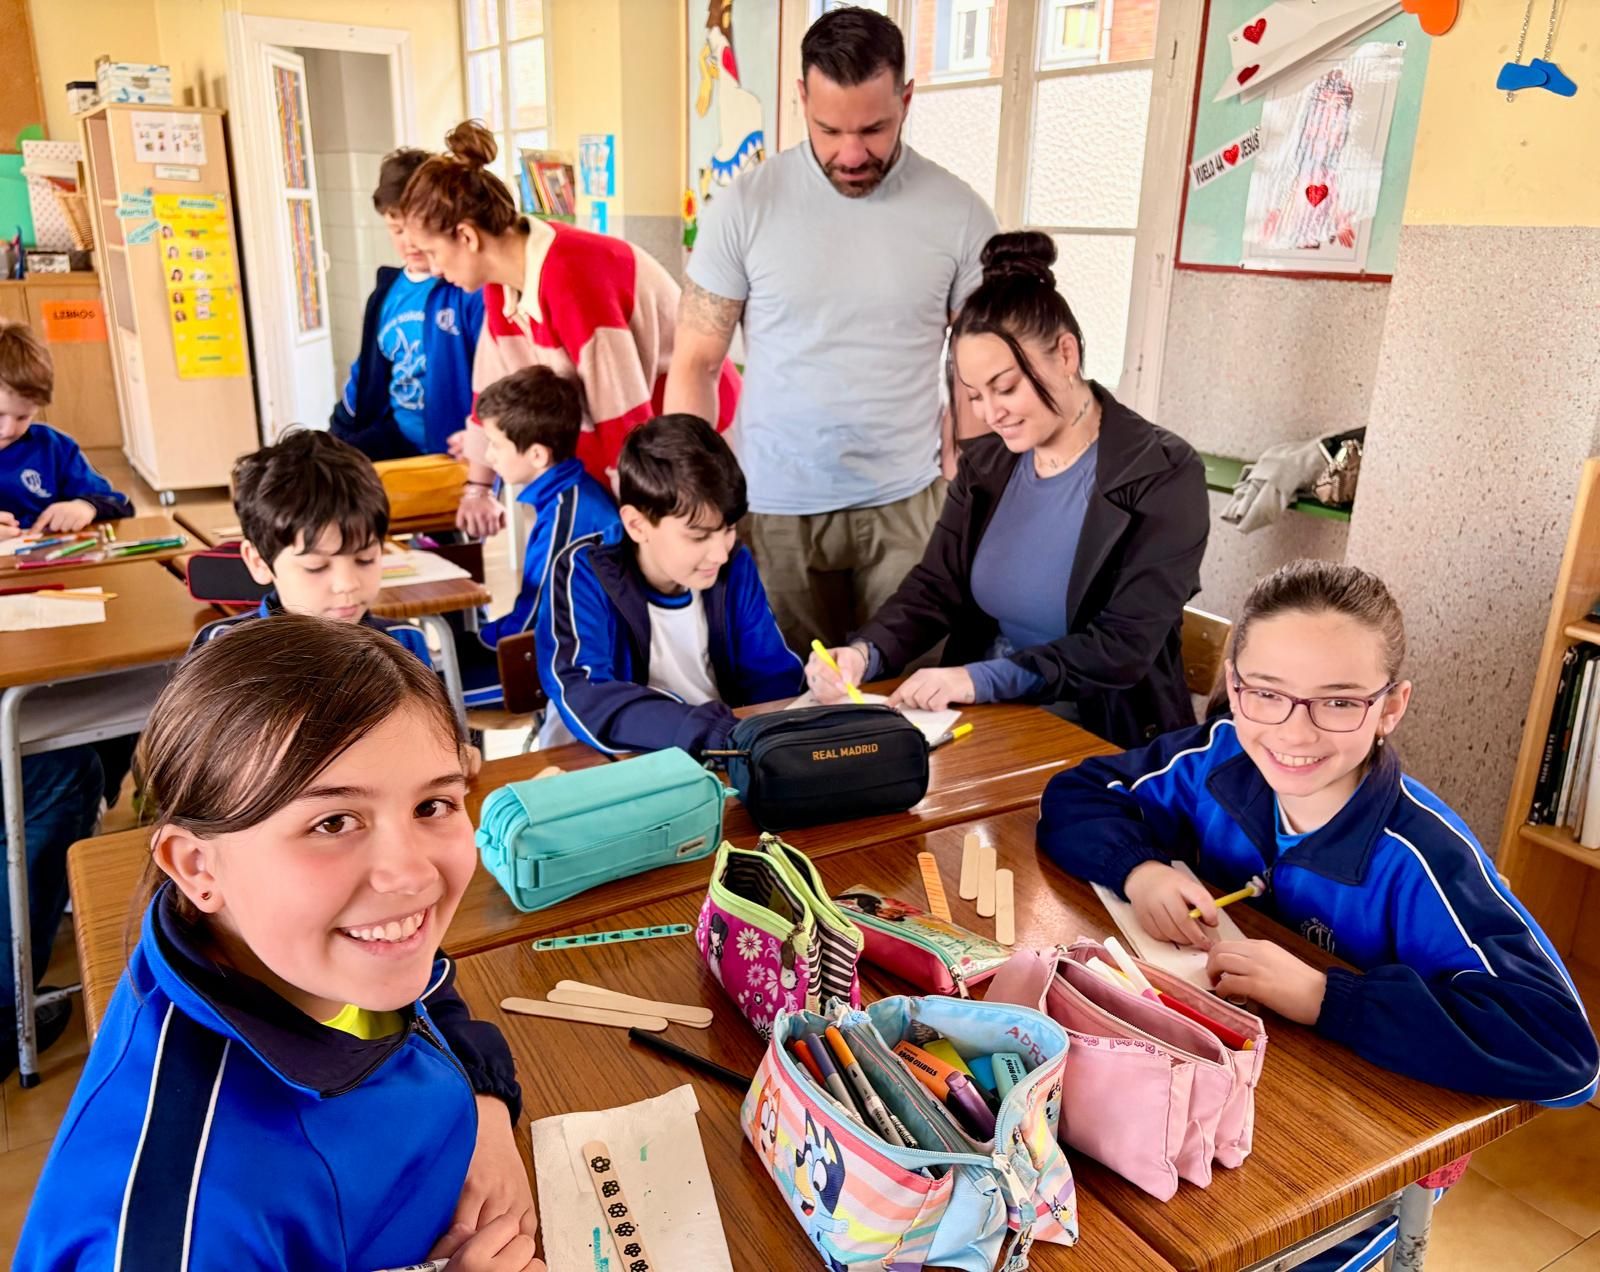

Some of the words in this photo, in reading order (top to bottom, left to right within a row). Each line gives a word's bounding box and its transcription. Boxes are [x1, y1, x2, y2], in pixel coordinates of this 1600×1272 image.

[1193, 159, 1215, 186] VUELO
[812, 748, 839, 761] REAL
[840, 743, 879, 757] MADRID
[913, 1059, 938, 1077] STABILO
[1005, 1059, 1017, 1074] BOSS
